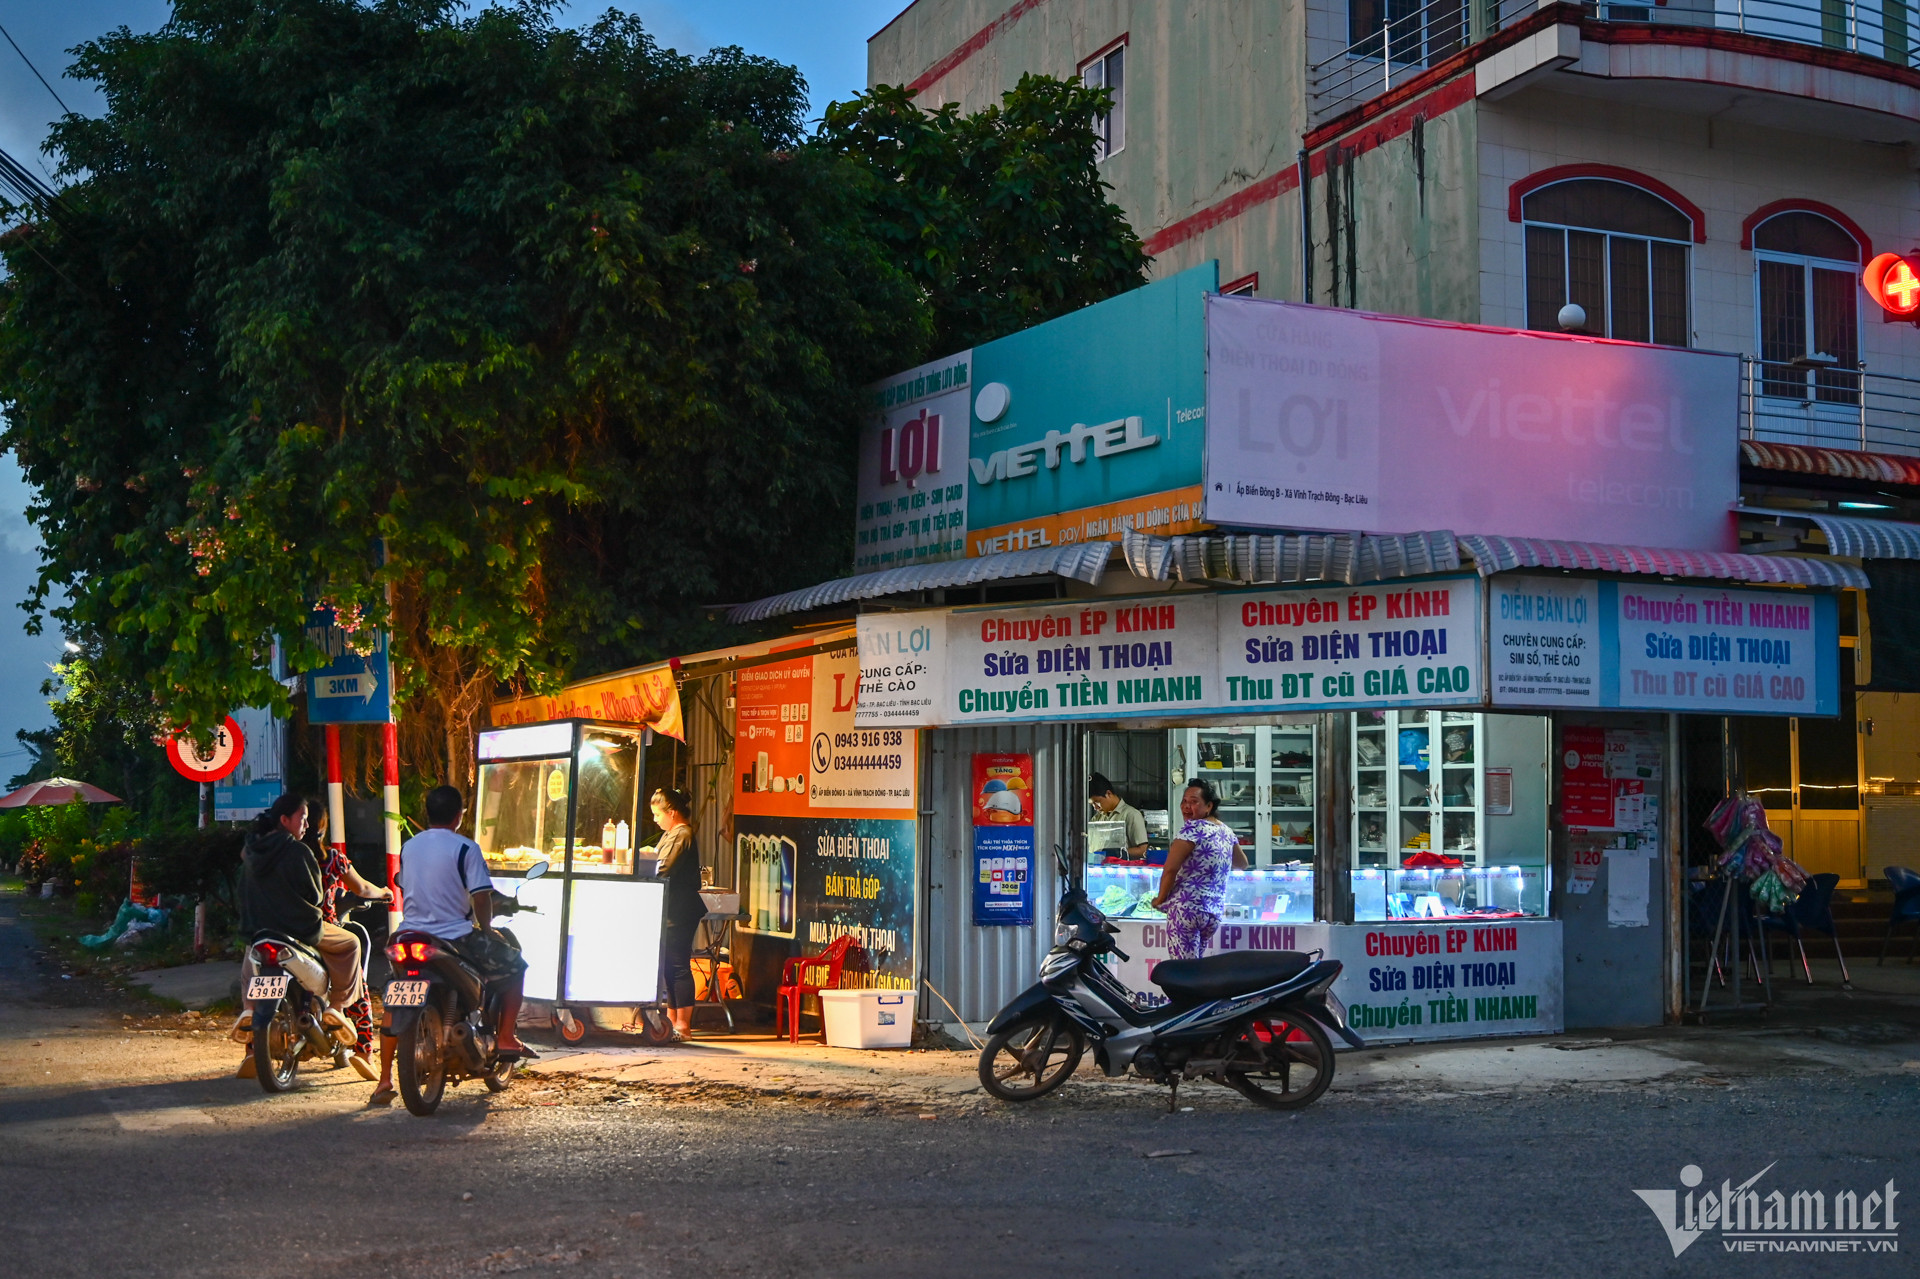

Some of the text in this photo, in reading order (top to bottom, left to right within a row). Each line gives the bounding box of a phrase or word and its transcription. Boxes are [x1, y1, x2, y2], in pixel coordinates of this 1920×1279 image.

[1238, 387, 1349, 475] LỢI
[1436, 378, 1694, 456] viettel
[880, 408, 942, 489] LỢI
[968, 415, 1162, 485] VIETTEL
[945, 483, 963, 502] CARD
[1259, 486, 1275, 500] Đông
[1275, 489, 1280, 497] B
[1284, 488, 1293, 498] Xã
[1293, 487, 1307, 499] Vĩnh
[1307, 490, 1325, 504] Trạch
[1325, 491, 1340, 505] Đông
[1344, 493, 1356, 506] Bạc
[1356, 493, 1369, 505] Liêu
[1568, 472, 1694, 512] telecom
[976, 528, 1052, 557] VIETTEL
[1059, 525, 1081, 545] pay
[1086, 519, 1109, 538] NGÂN
[1136, 512, 1145, 528] DI
[1146, 505, 1170, 531] ĐỘNG
[1172, 499, 1190, 522] CỦA
[980, 604, 1176, 643] Chuyên ÉP KÍNH
[1241, 588, 1450, 627] Chuyên ÉP KÍNH
[1501, 587, 1533, 620] ĐIỂM
[1567, 594, 1587, 628] LỢI
[1623, 592, 1810, 631] Chuyển TIỀN NHANH
[897, 625, 931, 657] LỢI
[1245, 628, 1448, 664] Sửa ĐIỆN THOẠI
[1503, 632, 1586, 649] CHUYÊN CUNG CẤP:
[1645, 631, 1792, 669] Sửa ĐIỆN THOẠI
[895, 660, 927, 676] CẤP:
[983, 640, 1173, 677] Sửa ĐIỆN THOẠI
[1509, 652, 1525, 664] SIM
[1543, 650, 1560, 666] THẺ
[1562, 651, 1580, 667] CÀO
[329, 678, 358, 694] 3KM
[754, 671, 769, 681] GIAO
[769, 669, 783, 683] DỊCH
[887, 678, 916, 692] CÀO
[1226, 664, 1470, 701] Thu ĐT cũ GIÁ CAO
[1630, 668, 1806, 702] Thu ĐT cũ GIÁ CAO
[958, 673, 1203, 714] Chuyển TIỀN NHANH
[756, 727, 776, 739] FPT Play
[834, 730, 902, 748] 0943 916 938
[1607, 743, 1625, 752] 120
[834, 754, 902, 771] 03444444459
[817, 830, 890, 864] SỬA ĐIỆN THOẠI
[1574, 850, 1600, 865] 120
[825, 870, 880, 900] BÁN TRẢ GÓP
[809, 921, 896, 955] MUA THOẠI
[1365, 922, 1518, 958] Chuyên ÉP KÍNH
[248, 987, 284, 998] 439.88
[254, 977, 282, 987] 94-K1
[392, 982, 423, 993] 94-K1
[1369, 958, 1516, 994] Sửa ĐIỆN THOẠI
[386, 993, 425, 1005] 076.05
[1348, 990, 1538, 1030] Chuyển TIỀN NHANH
